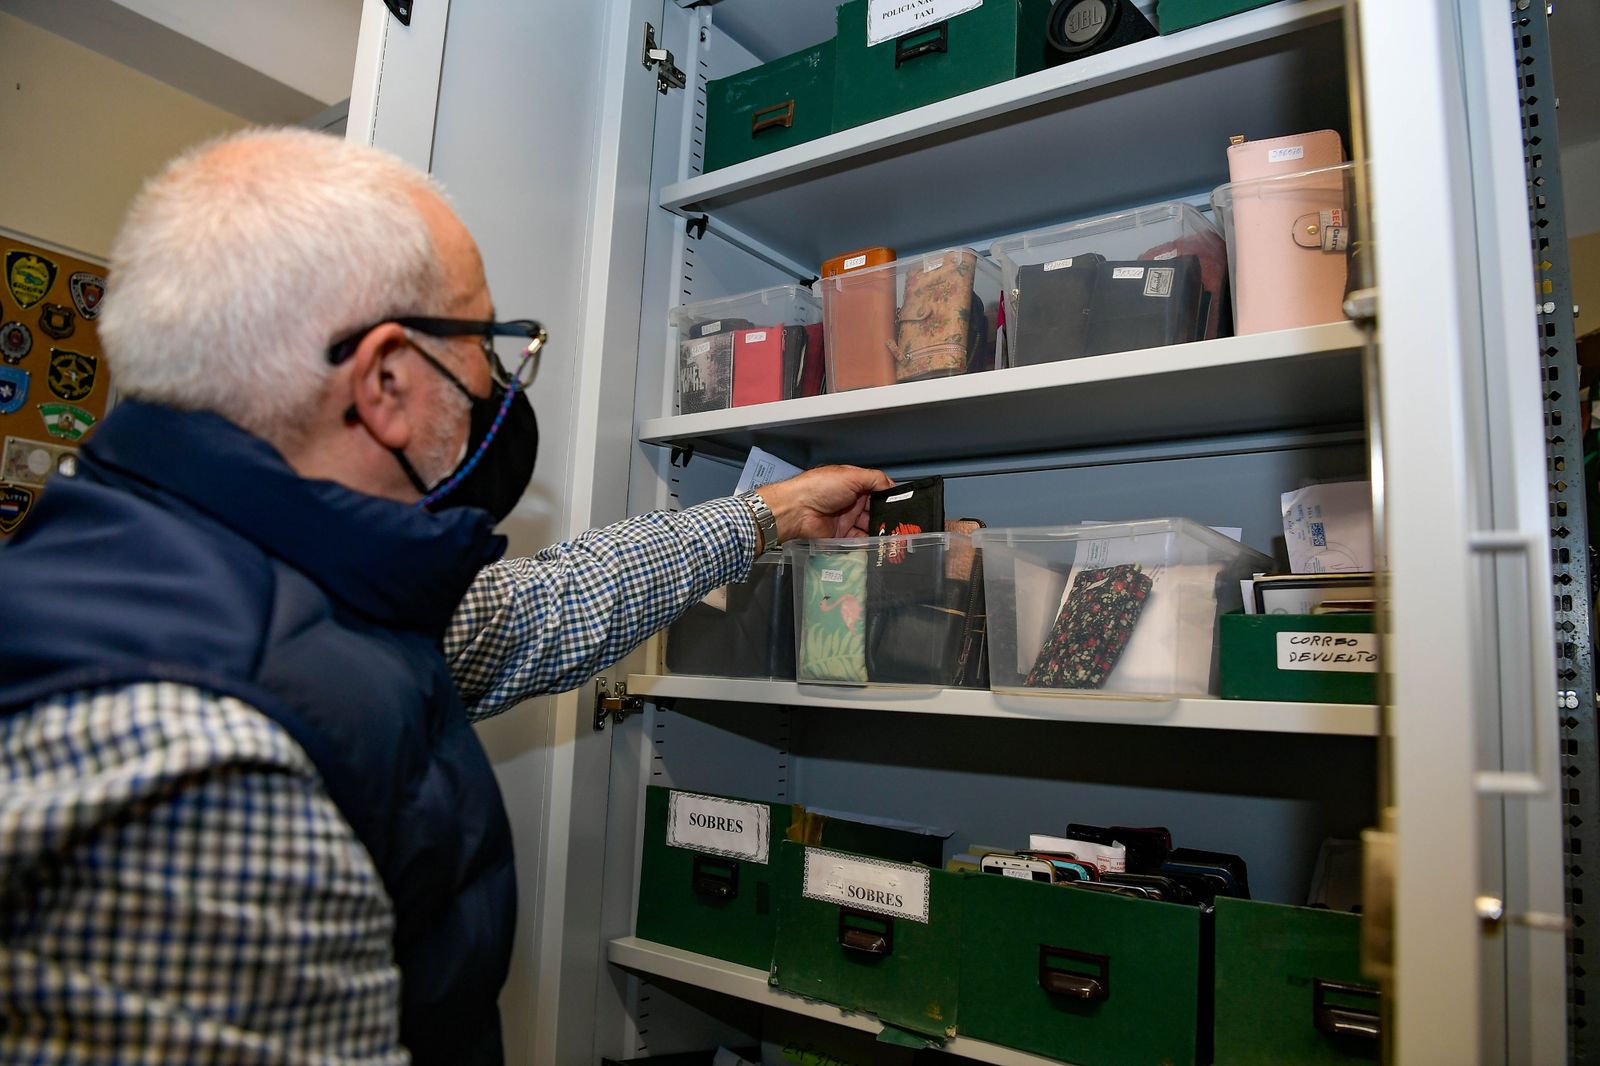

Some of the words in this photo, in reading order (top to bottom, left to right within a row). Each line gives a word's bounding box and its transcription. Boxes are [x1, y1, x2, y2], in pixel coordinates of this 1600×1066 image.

[882, 3, 915, 20] POLICIA
[914, 7, 934, 20] TAXI
[1069, 6, 1103, 33] JBL
[1290, 635, 1358, 647] CORREO
[1289, 650, 1378, 663] DEVUELTO
[688, 811, 744, 834] SOBRES
[846, 883, 903, 908] SOBRES
